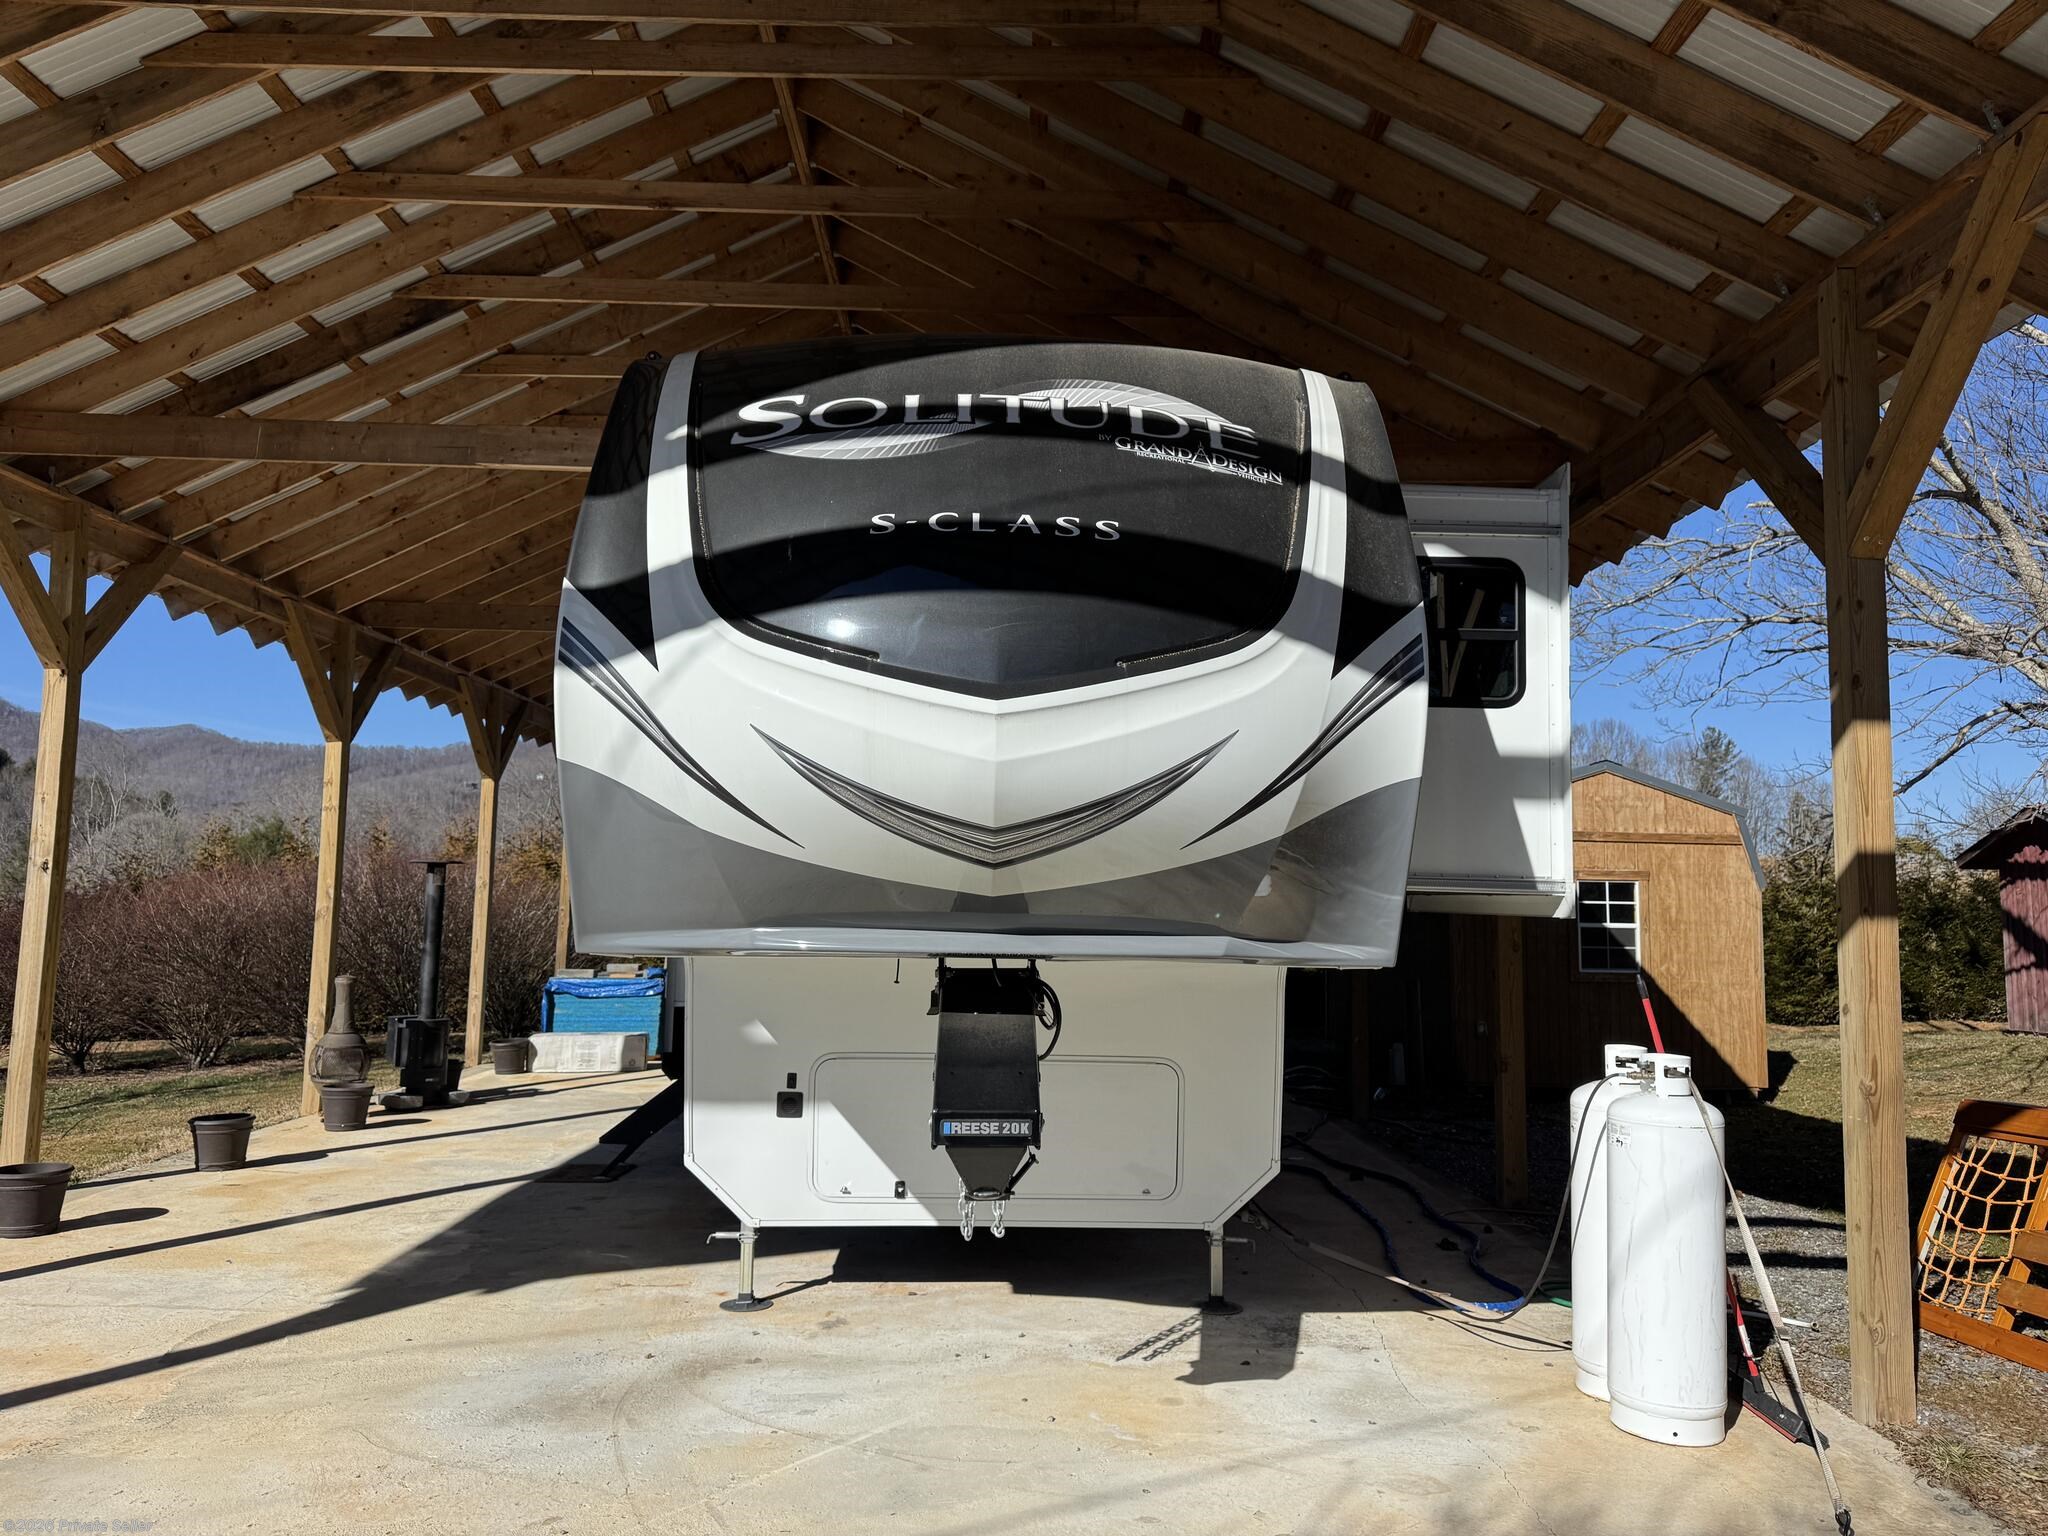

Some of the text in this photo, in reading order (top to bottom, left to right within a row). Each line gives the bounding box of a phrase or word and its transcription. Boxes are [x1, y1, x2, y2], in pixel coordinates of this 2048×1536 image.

[731, 393, 1260, 459] SOLITUDE
[1115, 437, 1282, 483] GRAND DESIGN
[1137, 452, 1186, 464] RECREATIONAL
[868, 512, 1122, 542] S-CLASS
[951, 1122, 1029, 1135] REESE 20K
